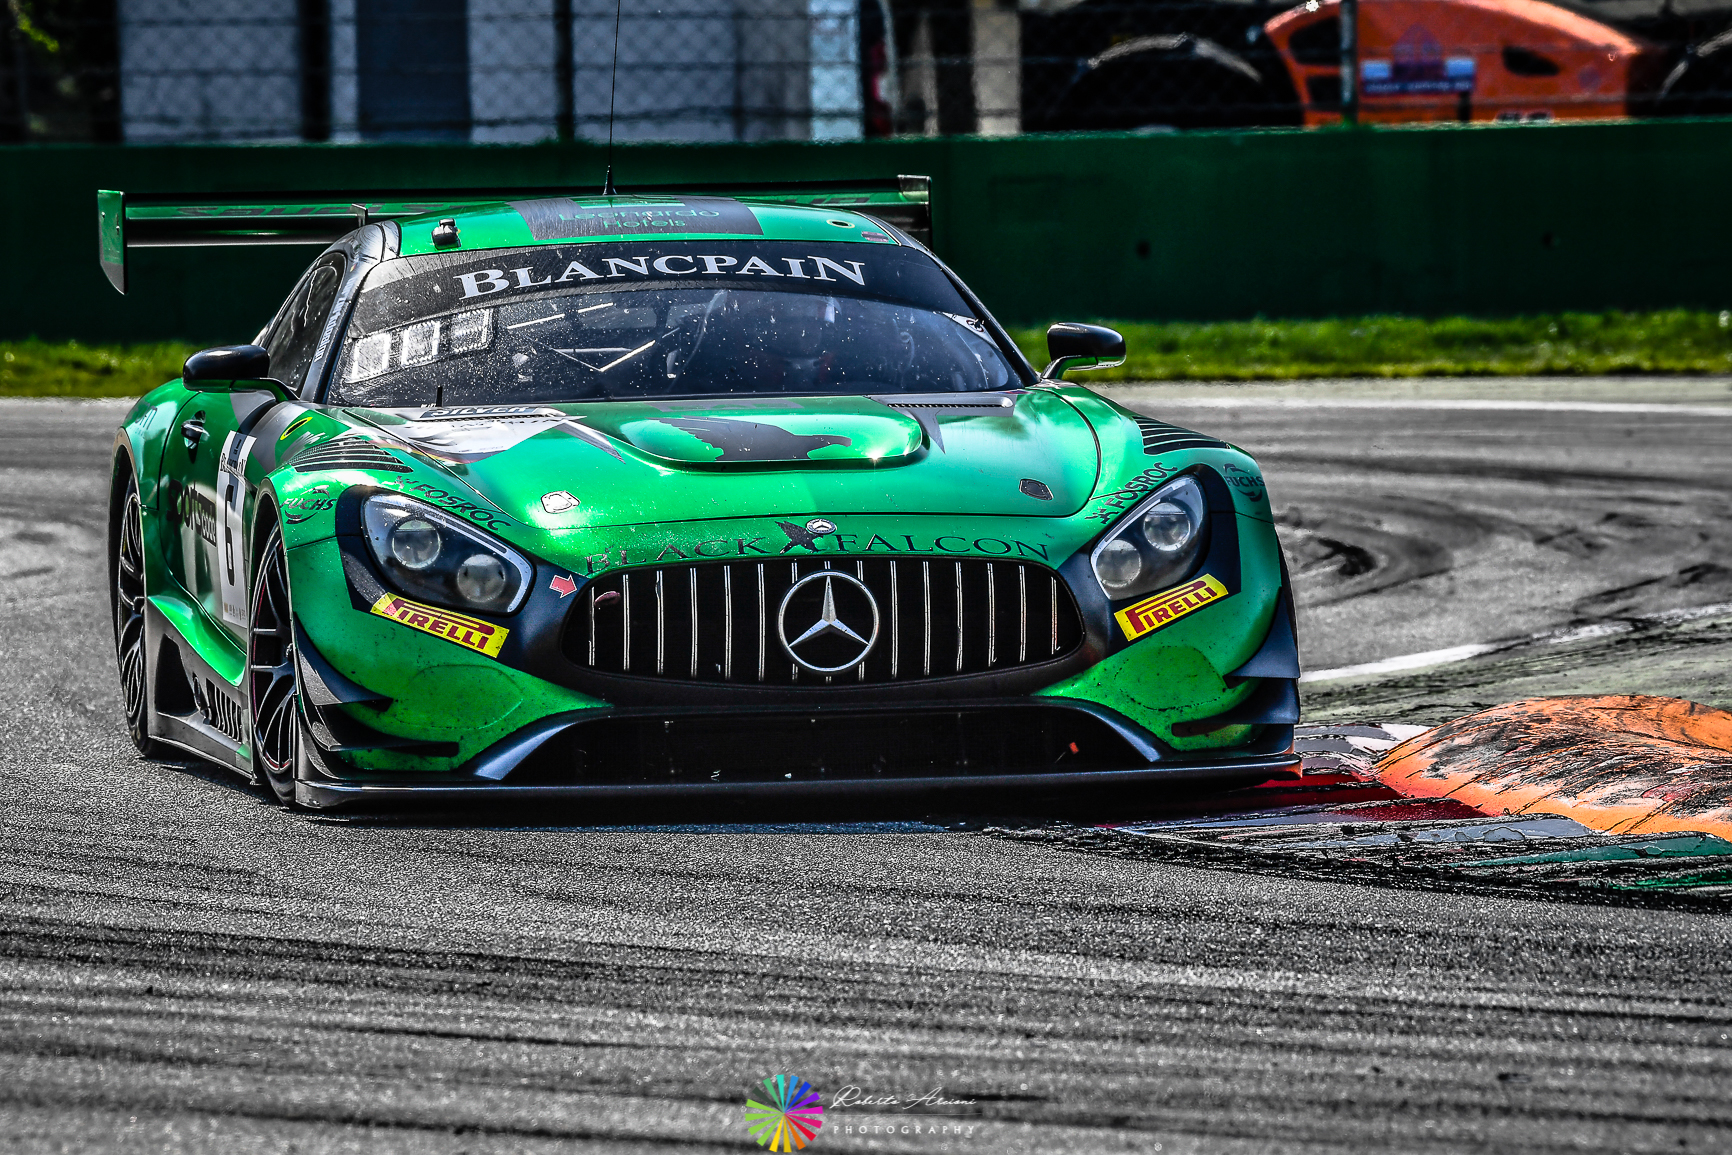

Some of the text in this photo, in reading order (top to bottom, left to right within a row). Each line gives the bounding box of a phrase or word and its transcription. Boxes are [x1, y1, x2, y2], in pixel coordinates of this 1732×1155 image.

[558, 209, 720, 221] Leonardo
[603, 219, 686, 228] Hotels
[453, 255, 866, 300] BLANCPAIN
[1104, 462, 1178, 509] FOSROC
[1223, 475, 1266, 488] FUCHS
[280, 498, 338, 511] FUCHS
[409, 483, 512, 531] FOSROC
[225, 485, 235, 587] 6
[584, 533, 1050, 577] BLACK FALCON
[382, 597, 496, 650] PIRELLI
[1125, 580, 1218, 634] PIRELLI
